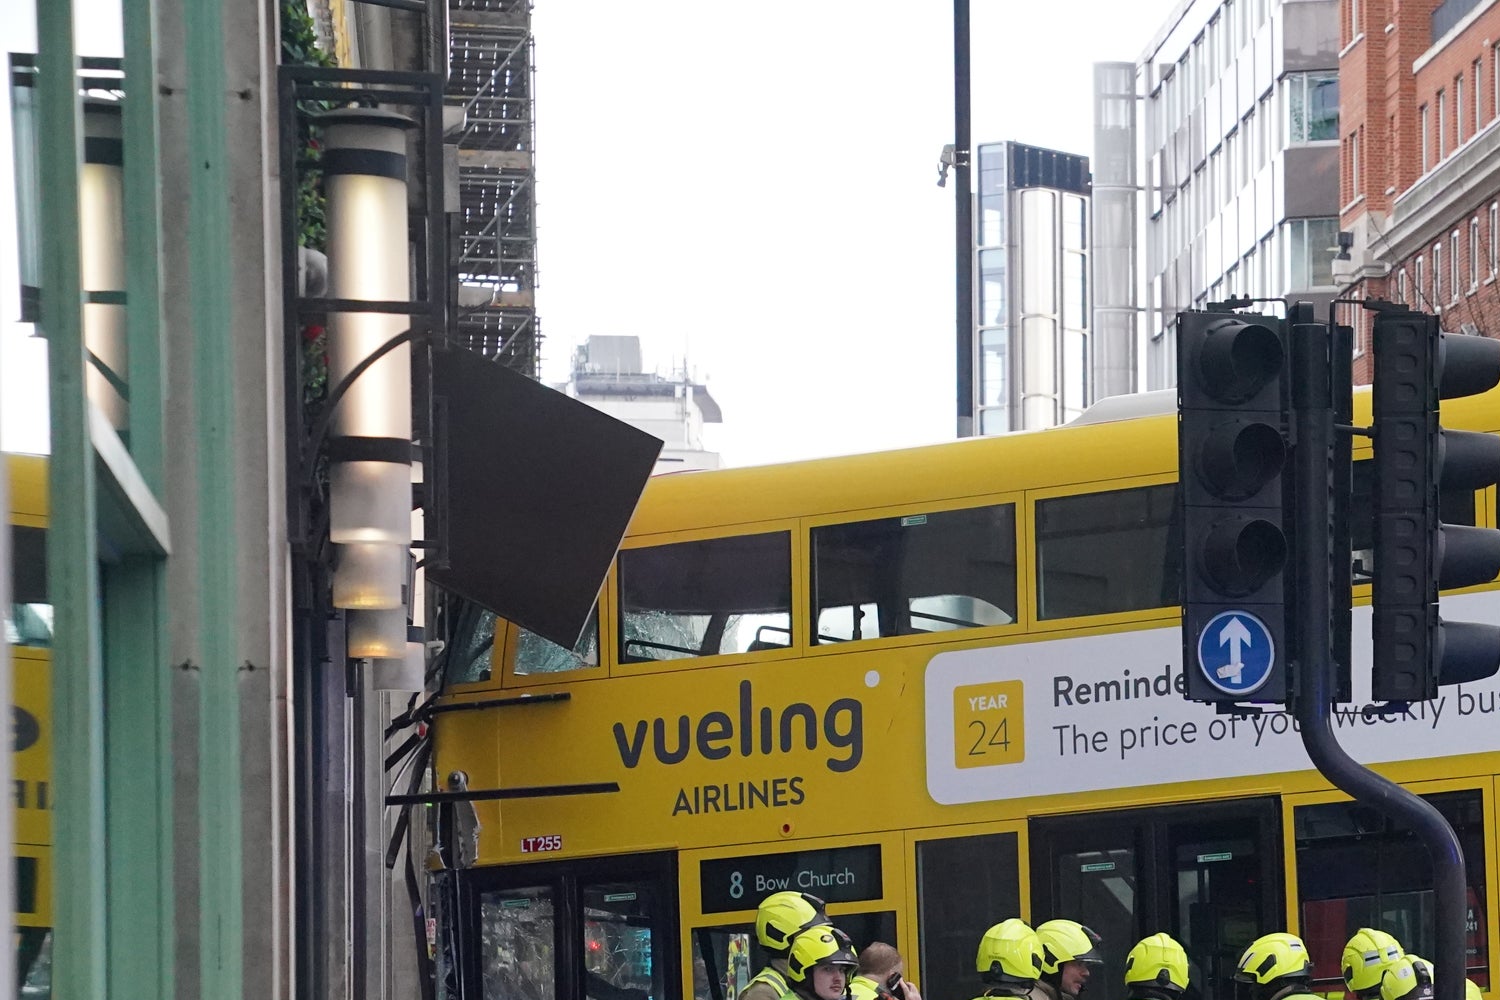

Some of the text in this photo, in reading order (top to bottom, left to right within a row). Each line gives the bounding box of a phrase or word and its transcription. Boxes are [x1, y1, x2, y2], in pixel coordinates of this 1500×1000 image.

[968, 693, 1009, 713] YEAR
[1053, 664, 1186, 707] Reminde
[613, 680, 864, 773] vueling
[967, 718, 1011, 757] 24
[1053, 723, 1108, 757] The
[1121, 716, 1198, 760] price
[1208, 713, 1242, 741] of
[672, 776, 806, 817] AIRLINES
[729, 868, 855, 899] 8 Bow Church
